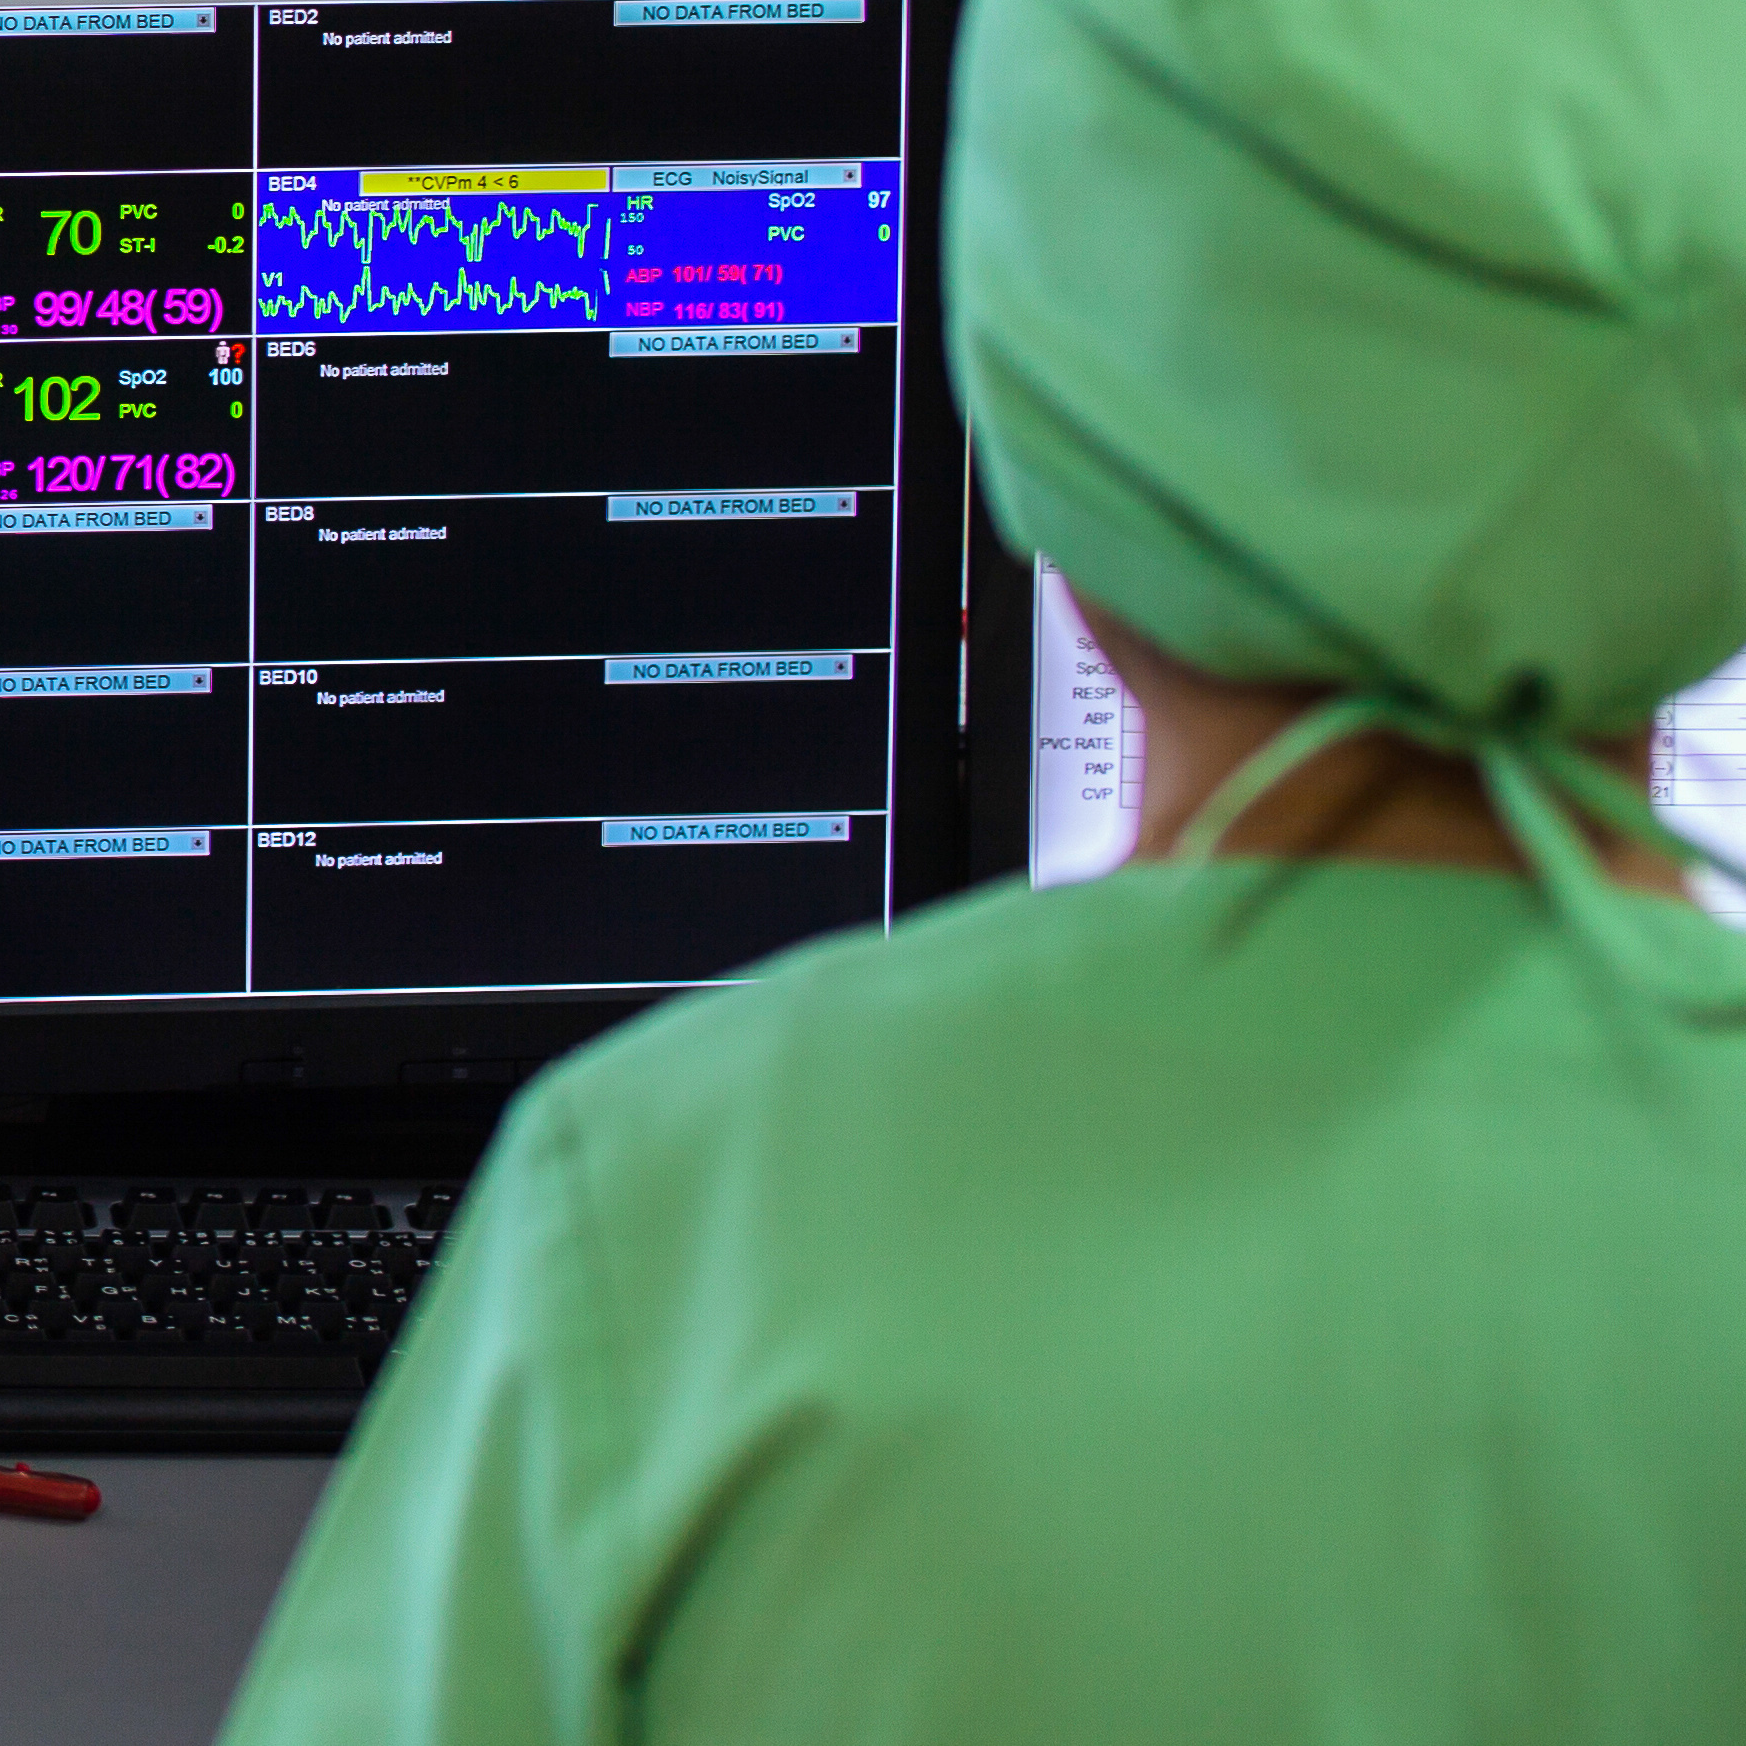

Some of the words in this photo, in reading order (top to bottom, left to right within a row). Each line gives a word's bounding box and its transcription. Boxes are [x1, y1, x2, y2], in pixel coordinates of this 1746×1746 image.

[269, 9, 318, 25] BED2
[643, 6, 669, 20] NO
[676, 5, 723, 19] DATA
[729, 5, 780, 18] FROM
[788, 4, 823, 18] BED
[24, 16, 72, 30] DATA
[78, 15, 130, 29] FROM
[137, 14, 173, 28] BED
[323, 33, 342, 45] No
[345, 32, 391, 48] patient
[393, 31, 452, 44] admitted
[269, 175, 317, 192] BED4
[477, 176, 486, 189] 4
[509, 175, 518, 189] 6
[653, 172, 691, 186] ECG
[713, 170, 808, 186] NoisySignal
[628, 196, 653, 210] HR
[769, 193, 815, 211] SpO2
[868, 191, 891, 208] 97
[120, 204, 157, 219] PVC
[232, 203, 244, 219] 0
[620, 213, 644, 224] 150
[41, 211, 101, 255] 70
[768, 226, 804, 241] PVC
[878, 224, 891, 241] 0
[208, 236, 244, 253] -0.2
[628, 245, 644, 256] 50
[262, 272, 283, 287] V1
[625, 268, 663, 283] ABP
[626, 302, 664, 316] NBP
[267, 342, 314, 356] BED6
[639, 338, 664, 351] NO
[672, 337, 718, 350] DATA
[724, 336, 775, 349] FROM
[782, 335, 818, 348] BED
[119, 369, 166, 388] SpO2
[209, 368, 242, 385] 100
[320, 365, 340, 377] No
[342, 364, 388, 379] patient
[390, 362, 448, 376] admitted
[14, 376, 100, 421] 102
[119, 403, 156, 418] PVC
[231, 401, 242, 418] 0
[265, 506, 314, 521] BED8
[637, 502, 662, 515] NO
[669, 501, 715, 514] DATA
[721, 500, 772, 513] FROM
[780, 498, 815, 512] BED
[23, 514, 69, 527] DATA
[76, 513, 128, 526] FROM
[135, 512, 170, 525] BED
[319, 529, 338, 541] No
[341, 528, 386, 544] patient
[388, 527, 446, 540] admitted
[260, 669, 317, 685] BED10
[634, 665, 659, 678] NO
[666, 663, 712, 678] DATA
[718, 662, 769, 676] FROM
[777, 661, 812, 675] BED
[23, 678, 69, 691] DATA
[75, 676, 127, 690] FROM
[134, 675, 170, 689] BED
[317, 692, 337, 704] No
[339, 691, 384, 707] patient
[386, 690, 444, 703] admitted
[1073, 687, 1116, 699] RESP
[1084, 712, 1115, 724] ABP
[1040, 738, 1071, 750] PVC
[1075, 738, 1114, 750] RATE
[1085, 763, 1114, 775] PAP
[1082, 788, 1113, 800] CVP
[258, 832, 316, 847] BED12
[632, 827, 656, 840] NO
[664, 826, 708, 839] DATA
[716, 824, 766, 837] FROM
[774, 823, 808, 836] BED
[22, 840, 68, 854] DATA
[74, 839, 126, 852] FROM
[133, 838, 168, 851] BED
[316, 855, 335, 866] No
[338, 854, 382, 869] patient
[385, 852, 442, 865] admitted
